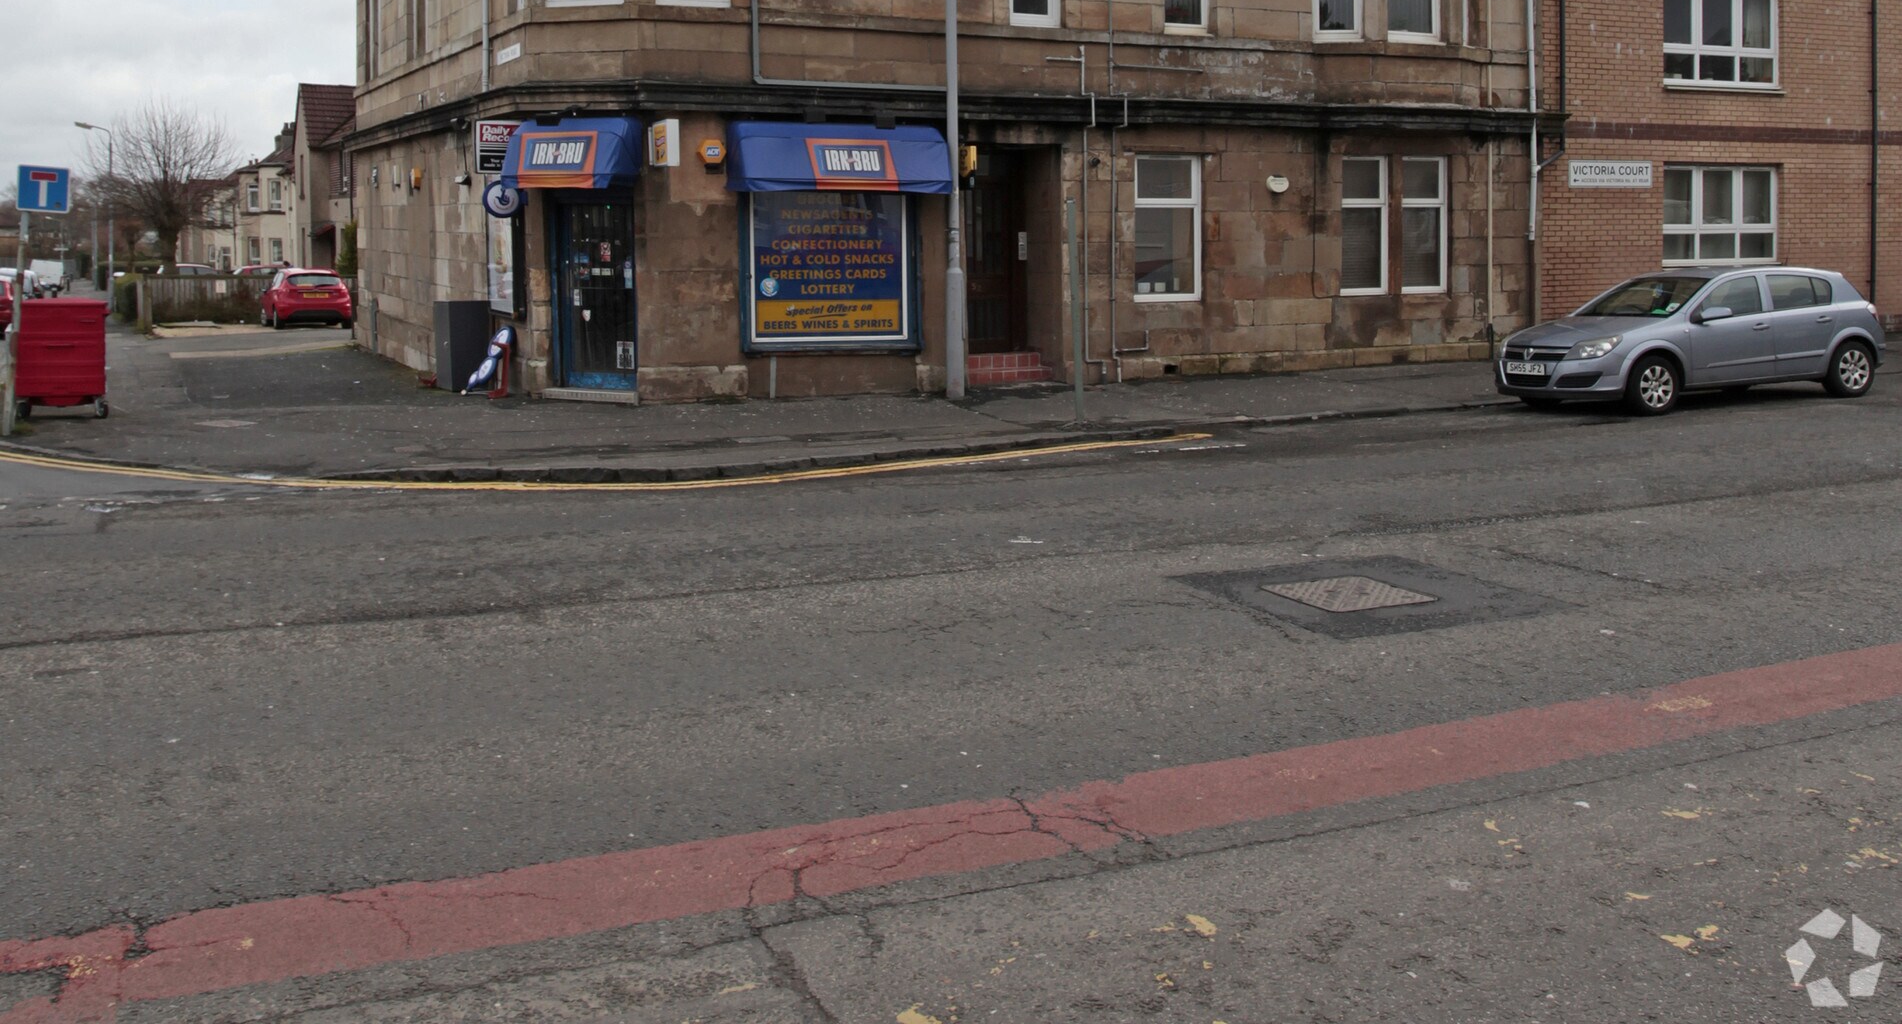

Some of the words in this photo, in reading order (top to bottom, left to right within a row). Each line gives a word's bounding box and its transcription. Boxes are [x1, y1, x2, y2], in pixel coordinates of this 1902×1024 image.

[482, 125, 510, 135] Daily
[482, 134, 510, 142] Reco
[1573, 165, 1616, 176] VICTORIA
[1618, 165, 1650, 176] COURT
[781, 208, 874, 220] NEWSAGENTS
[787, 224, 868, 235] CIGARETTES
[771, 239, 884, 250] CONFECTIONERY
[760, 255, 789, 265] HOT
[792, 255, 802, 265] &
[806, 254, 841, 265] COLD
[844, 253, 895, 264] SNACKS
[769, 269, 842, 280] GREETINGS
[845, 268, 887, 279] CARDS
[801, 284, 855, 295] LOTTERY
[786, 305, 824, 317] Special
[827, 303, 858, 314] Offers
[763, 320, 798, 330] BEERS
[801, 319, 839, 329] WINES
[842, 319, 850, 329] &
[853, 319, 894, 329] SPIRITS
